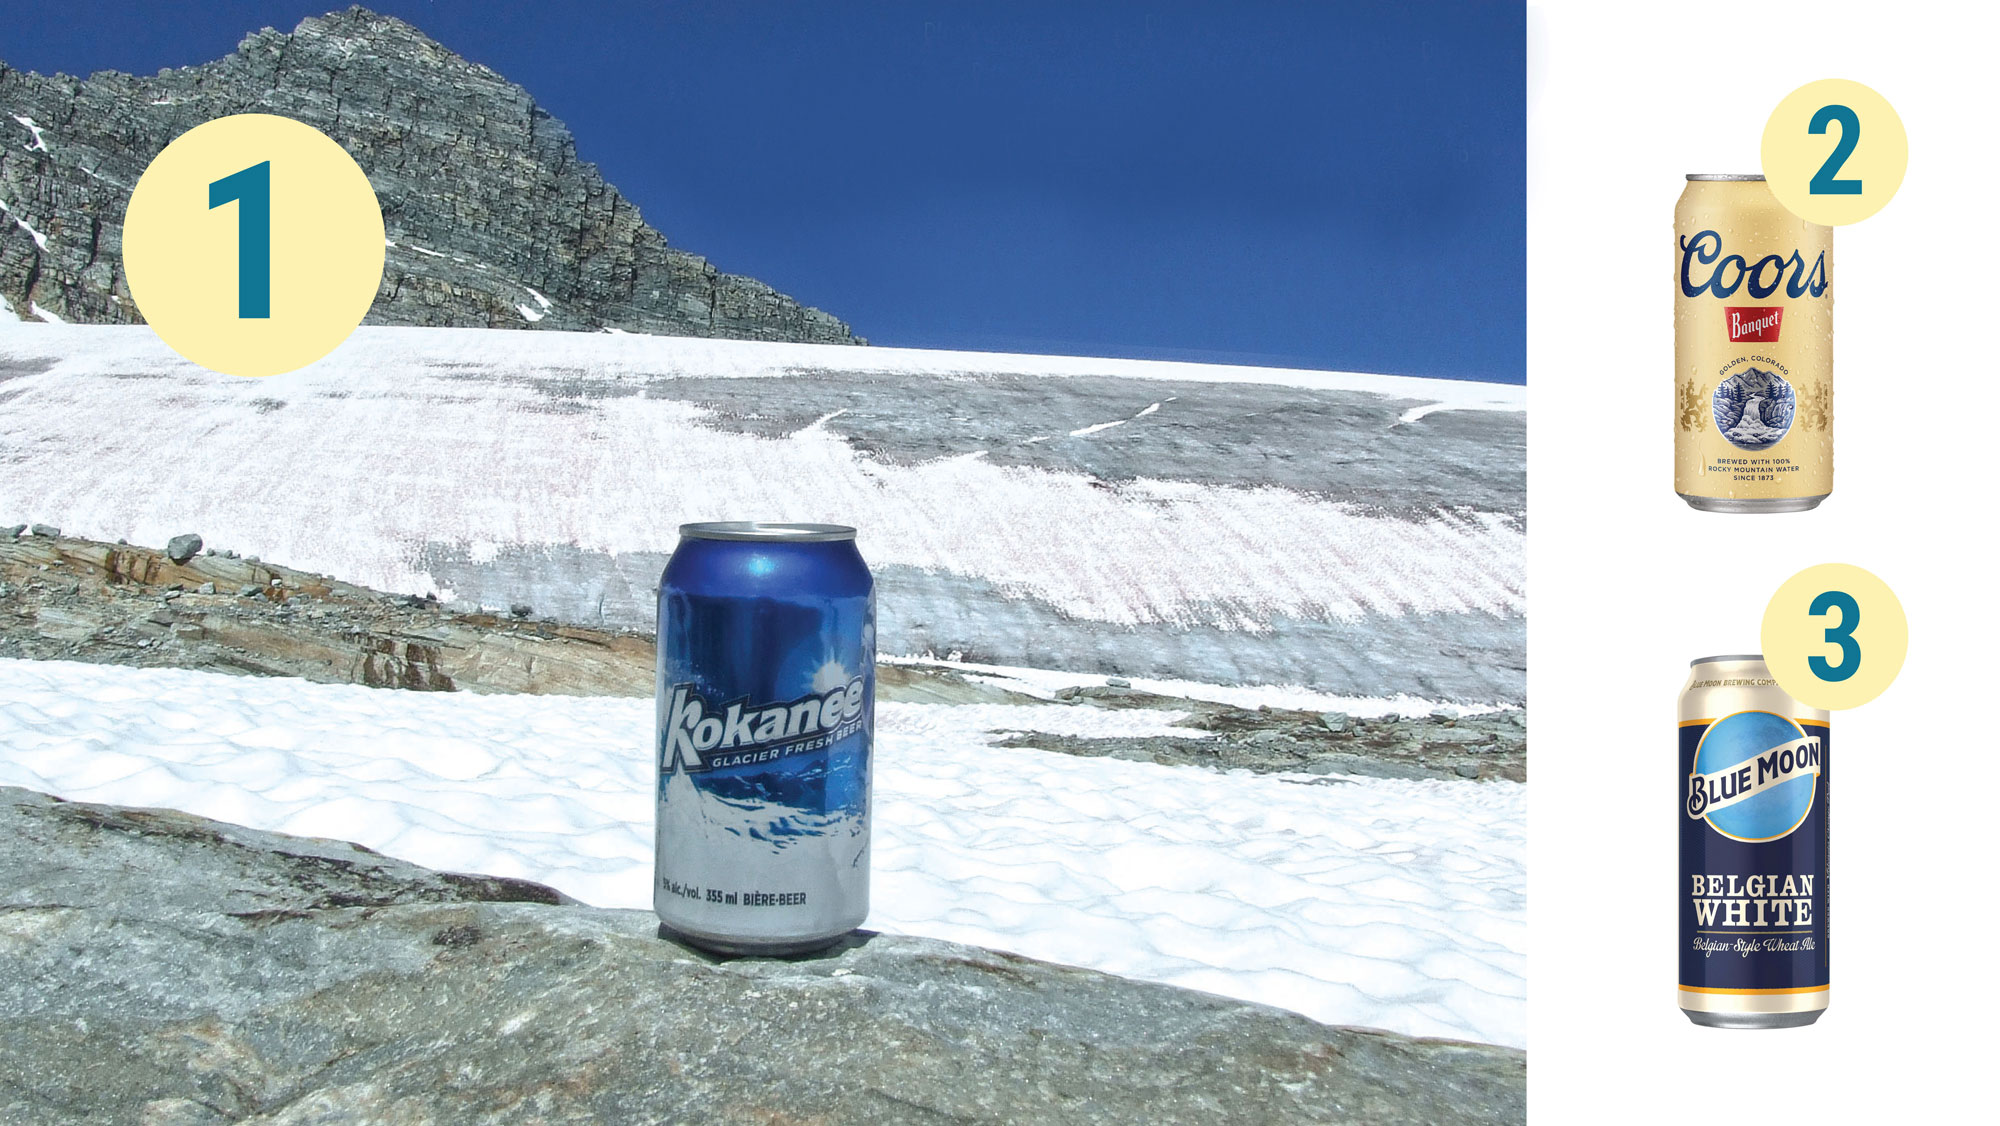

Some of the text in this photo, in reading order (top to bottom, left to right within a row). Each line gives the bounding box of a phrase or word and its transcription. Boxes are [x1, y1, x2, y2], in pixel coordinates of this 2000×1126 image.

[1680, 230, 1829, 300] Coors
[1732, 311, 1780, 340] Banquet
[1719, 355, 1789, 376] GOLDEN, COLORADO
[1708, 465, 1732, 473] ROCKY
[1775, 465, 1800, 473] WATER
[1703, 679, 1722, 688] MOON
[1723, 679, 1755, 687] BREWING
[660, 678, 865, 771] Kokanee
[712, 719, 862, 769] GLACIER FRESH BEER
[1689, 742, 1820, 816] BLUE MOON
[671, 880, 702, 900] alc./vol.
[706, 888, 723, 904] 355
[725, 891, 738, 905] ml
[1691, 874, 1815, 897] BELGIAN
[1692, 898, 1813, 927] WHITE
[1692, 936, 1816, 958] Belgian-Style Wheat Ale
